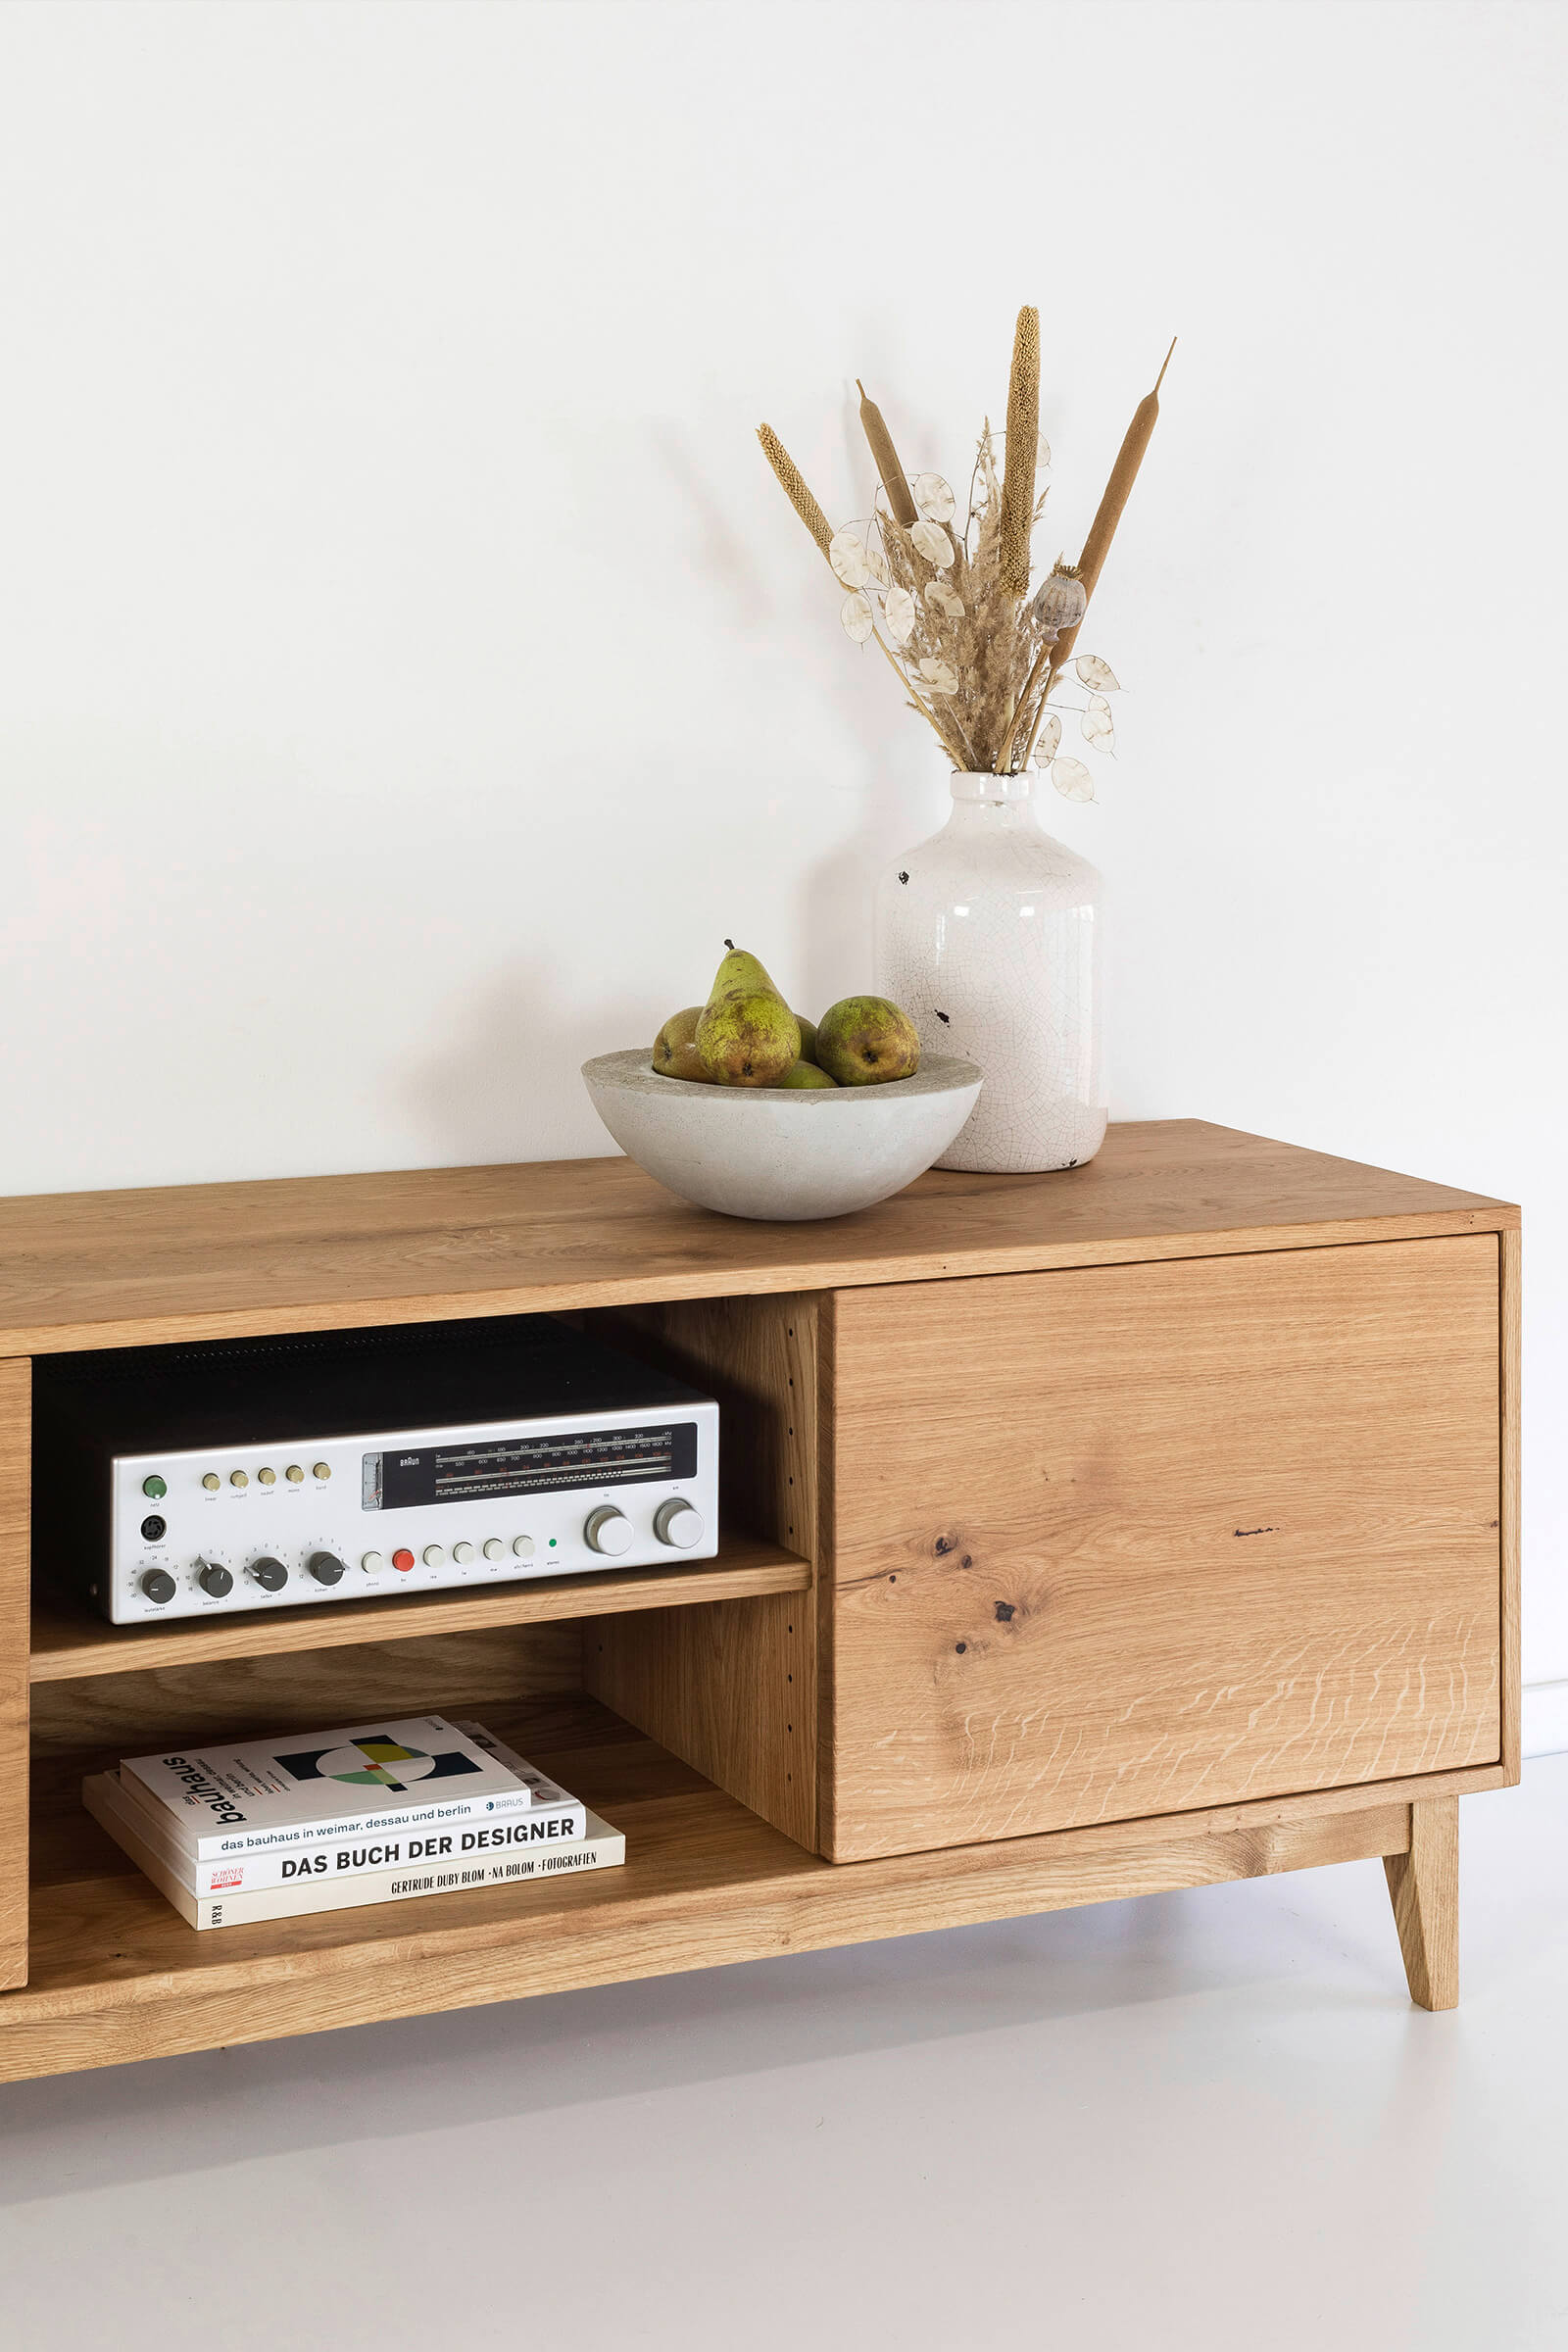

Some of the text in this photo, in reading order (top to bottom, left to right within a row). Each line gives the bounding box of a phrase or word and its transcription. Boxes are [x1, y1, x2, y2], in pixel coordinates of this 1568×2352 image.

[400, 1456, 419, 1466] BRAUN
[163, 1756, 247, 1825] bauhaus
[495, 1797, 523, 1809] BRAUS
[221, 1804, 470, 1851] das bauhaus in weimar, dessau und berlin
[282, 1818, 574, 1878] DAS BUCH DER DESIGNER
[391, 1876, 435, 1894] GERTRUDE
[437, 1872, 460, 1887] DUBY
[462, 1868, 485, 1884] BLOM
[506, 1860, 535, 1877] BOLOM
[212, 1905, 222, 1925] R&B
